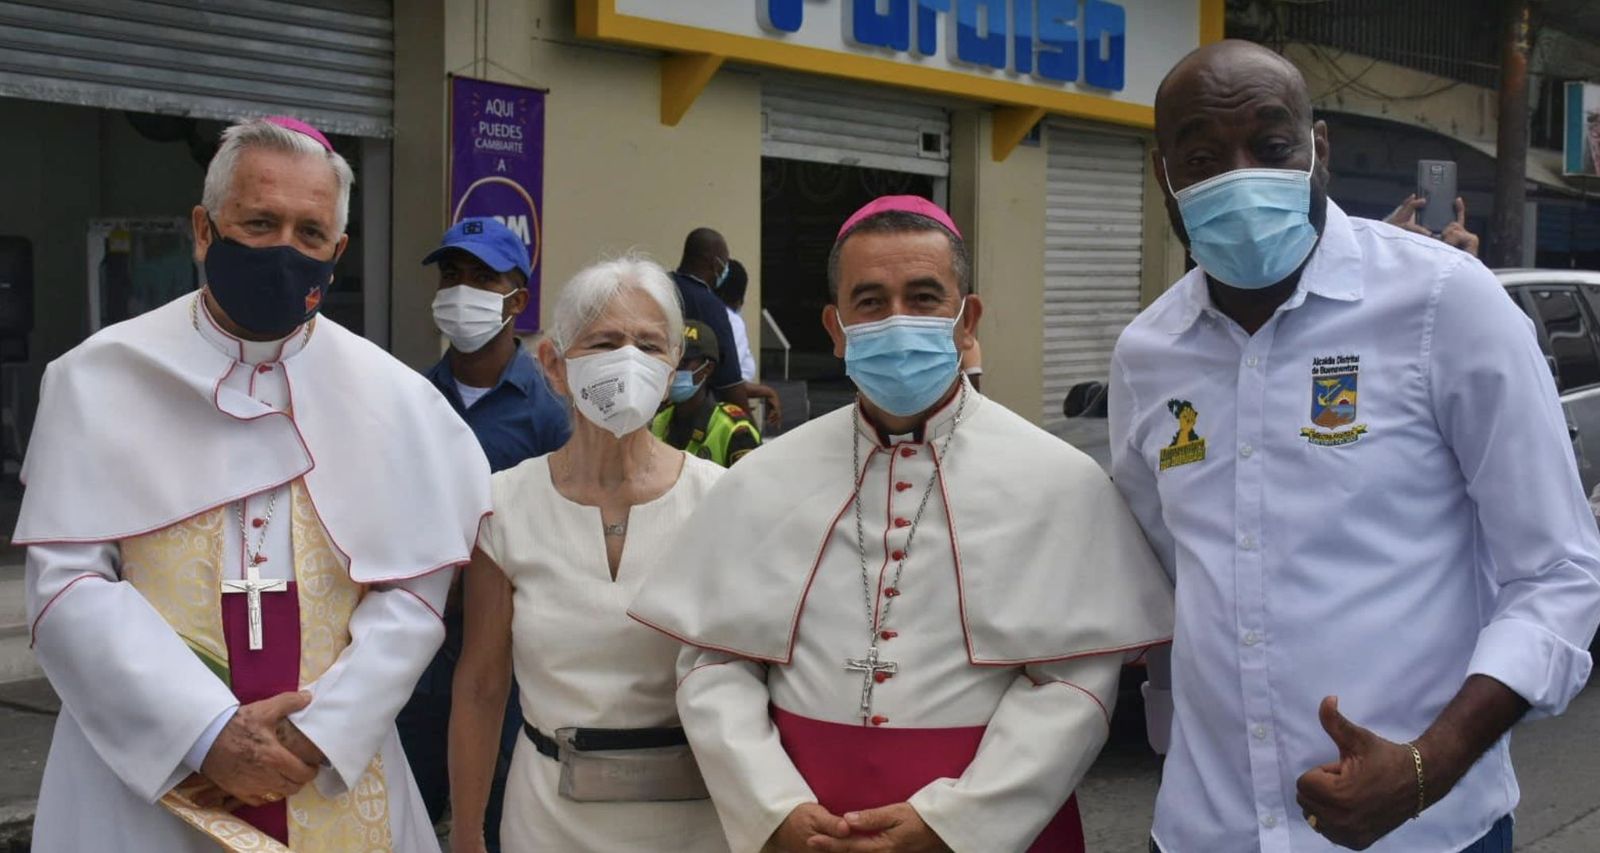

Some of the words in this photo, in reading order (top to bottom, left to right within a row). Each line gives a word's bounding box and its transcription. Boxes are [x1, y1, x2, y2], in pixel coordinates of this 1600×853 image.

[485, 98, 514, 118] AQUI
[479, 121, 523, 139] PUEDES
[474, 137, 523, 153] CAMBIARTE
[497, 158, 506, 172] A
[1312, 366, 1319, 374] de
